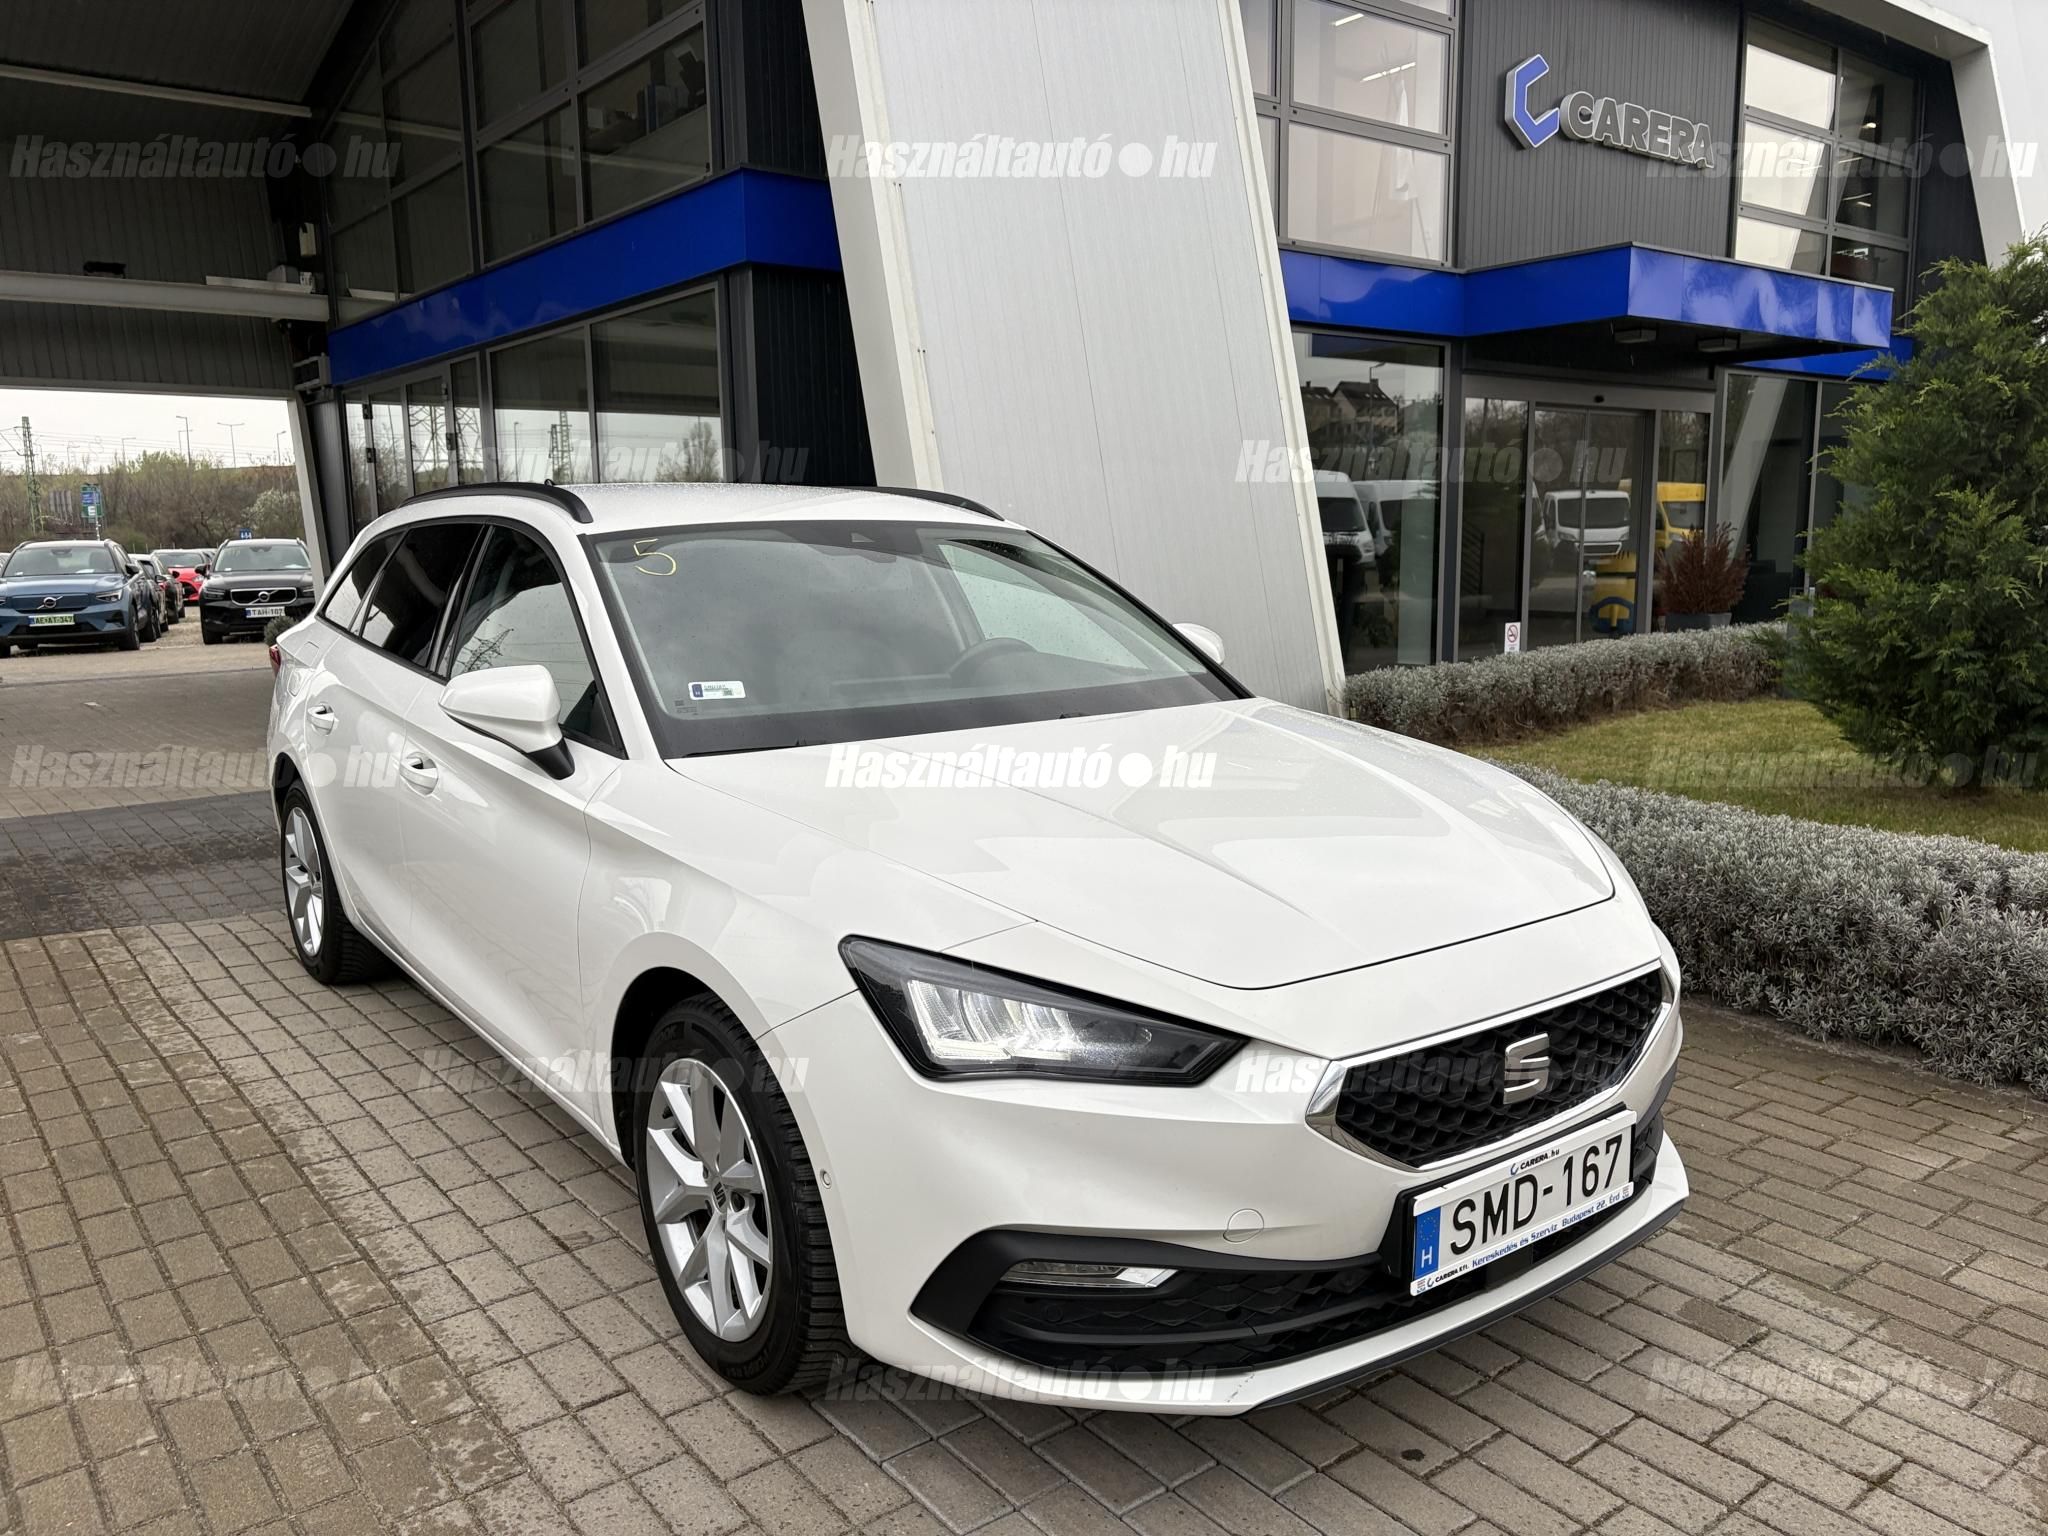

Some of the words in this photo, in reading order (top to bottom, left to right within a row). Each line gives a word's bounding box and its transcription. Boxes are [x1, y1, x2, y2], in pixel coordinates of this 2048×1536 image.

[1560, 91, 1715, 168] CARERA
[633, 538, 677, 576] 5
[1450, 1133, 1623, 1255] SMD-167
[1421, 1246, 1433, 1268] H
[1435, 1267, 1459, 1283] CARERA
[1472, 1242, 1518, 1267] Kereskedés
[1519, 1237, 1529, 1248] és
[1561, 1206, 1595, 1227] Budapest
